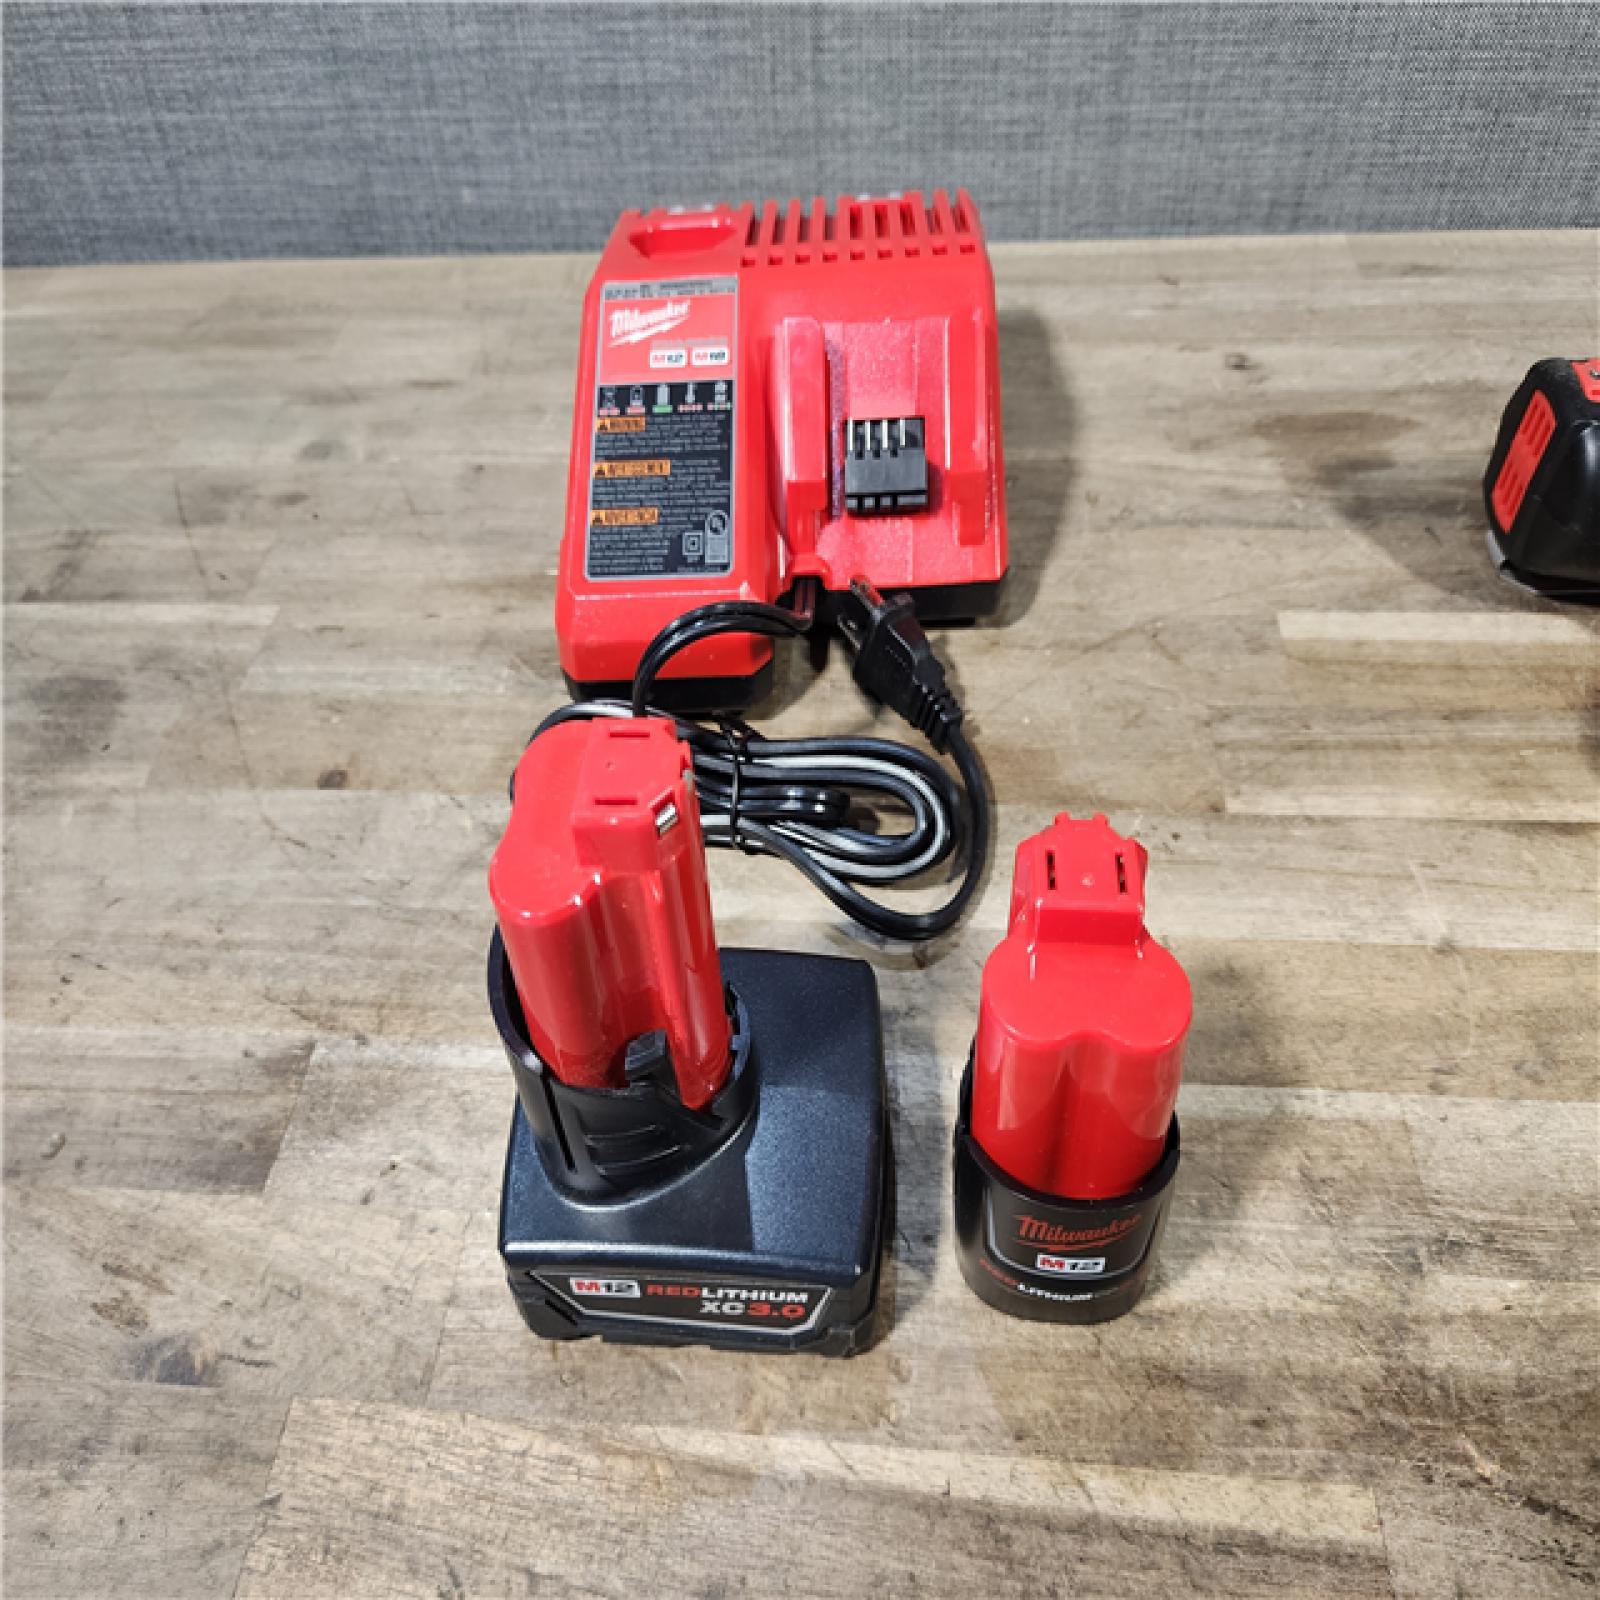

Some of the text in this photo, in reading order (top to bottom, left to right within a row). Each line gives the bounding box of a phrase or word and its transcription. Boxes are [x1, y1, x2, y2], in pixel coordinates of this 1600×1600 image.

[1014, 1214, 1142, 1242] Milwaukee
[1039, 1256, 1101, 1271] M12
[574, 1278, 637, 1298] M12
